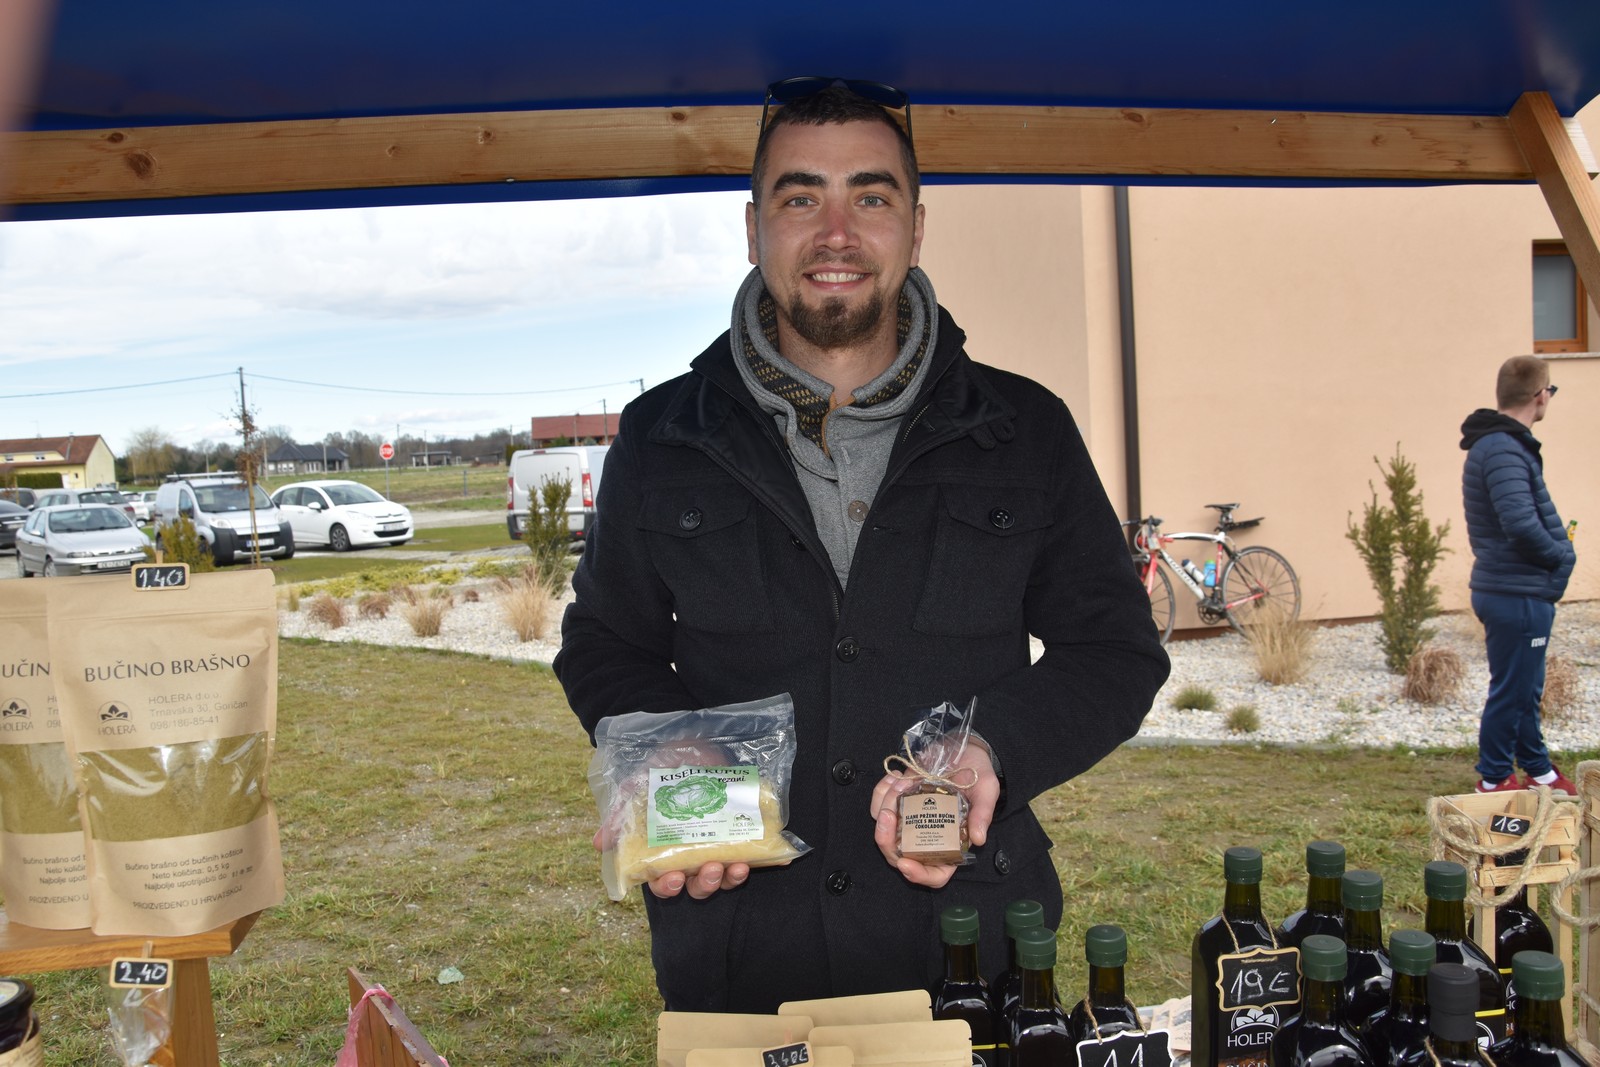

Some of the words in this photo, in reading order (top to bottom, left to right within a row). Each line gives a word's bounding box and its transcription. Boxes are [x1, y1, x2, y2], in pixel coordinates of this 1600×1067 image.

[2, 658, 50, 678] UČIN
[84, 660, 165, 683] BUČINO
[171, 653, 250, 675] BRAŠNO
[149, 692, 193, 704] HOLERA
[150, 706, 194, 718] Trnavska
[214, 700, 248, 712] Goričan
[98, 724, 136, 736] HOLERA
[150, 715, 220, 731] 098/186-85-41
[660, 768, 700, 782] KISELI
[1495, 816, 1520, 832] 16
[71, 854, 80, 862] od
[125, 862, 149, 871] Bučino
[151, 860, 177, 870] brašno
[192, 854, 219, 865] bučinih
[152, 872, 171, 880] Neto
[207, 864, 219, 873] 0,5
[221, 862, 230, 871] kg
[144, 882, 175, 892] Najbolje
[218, 872, 227, 880] do
[132, 900, 189, 910] PROIZVEDENO
[200, 885, 242, 905] HRVATSKOJ
[1227, 1031, 1274, 1048] HOLER
